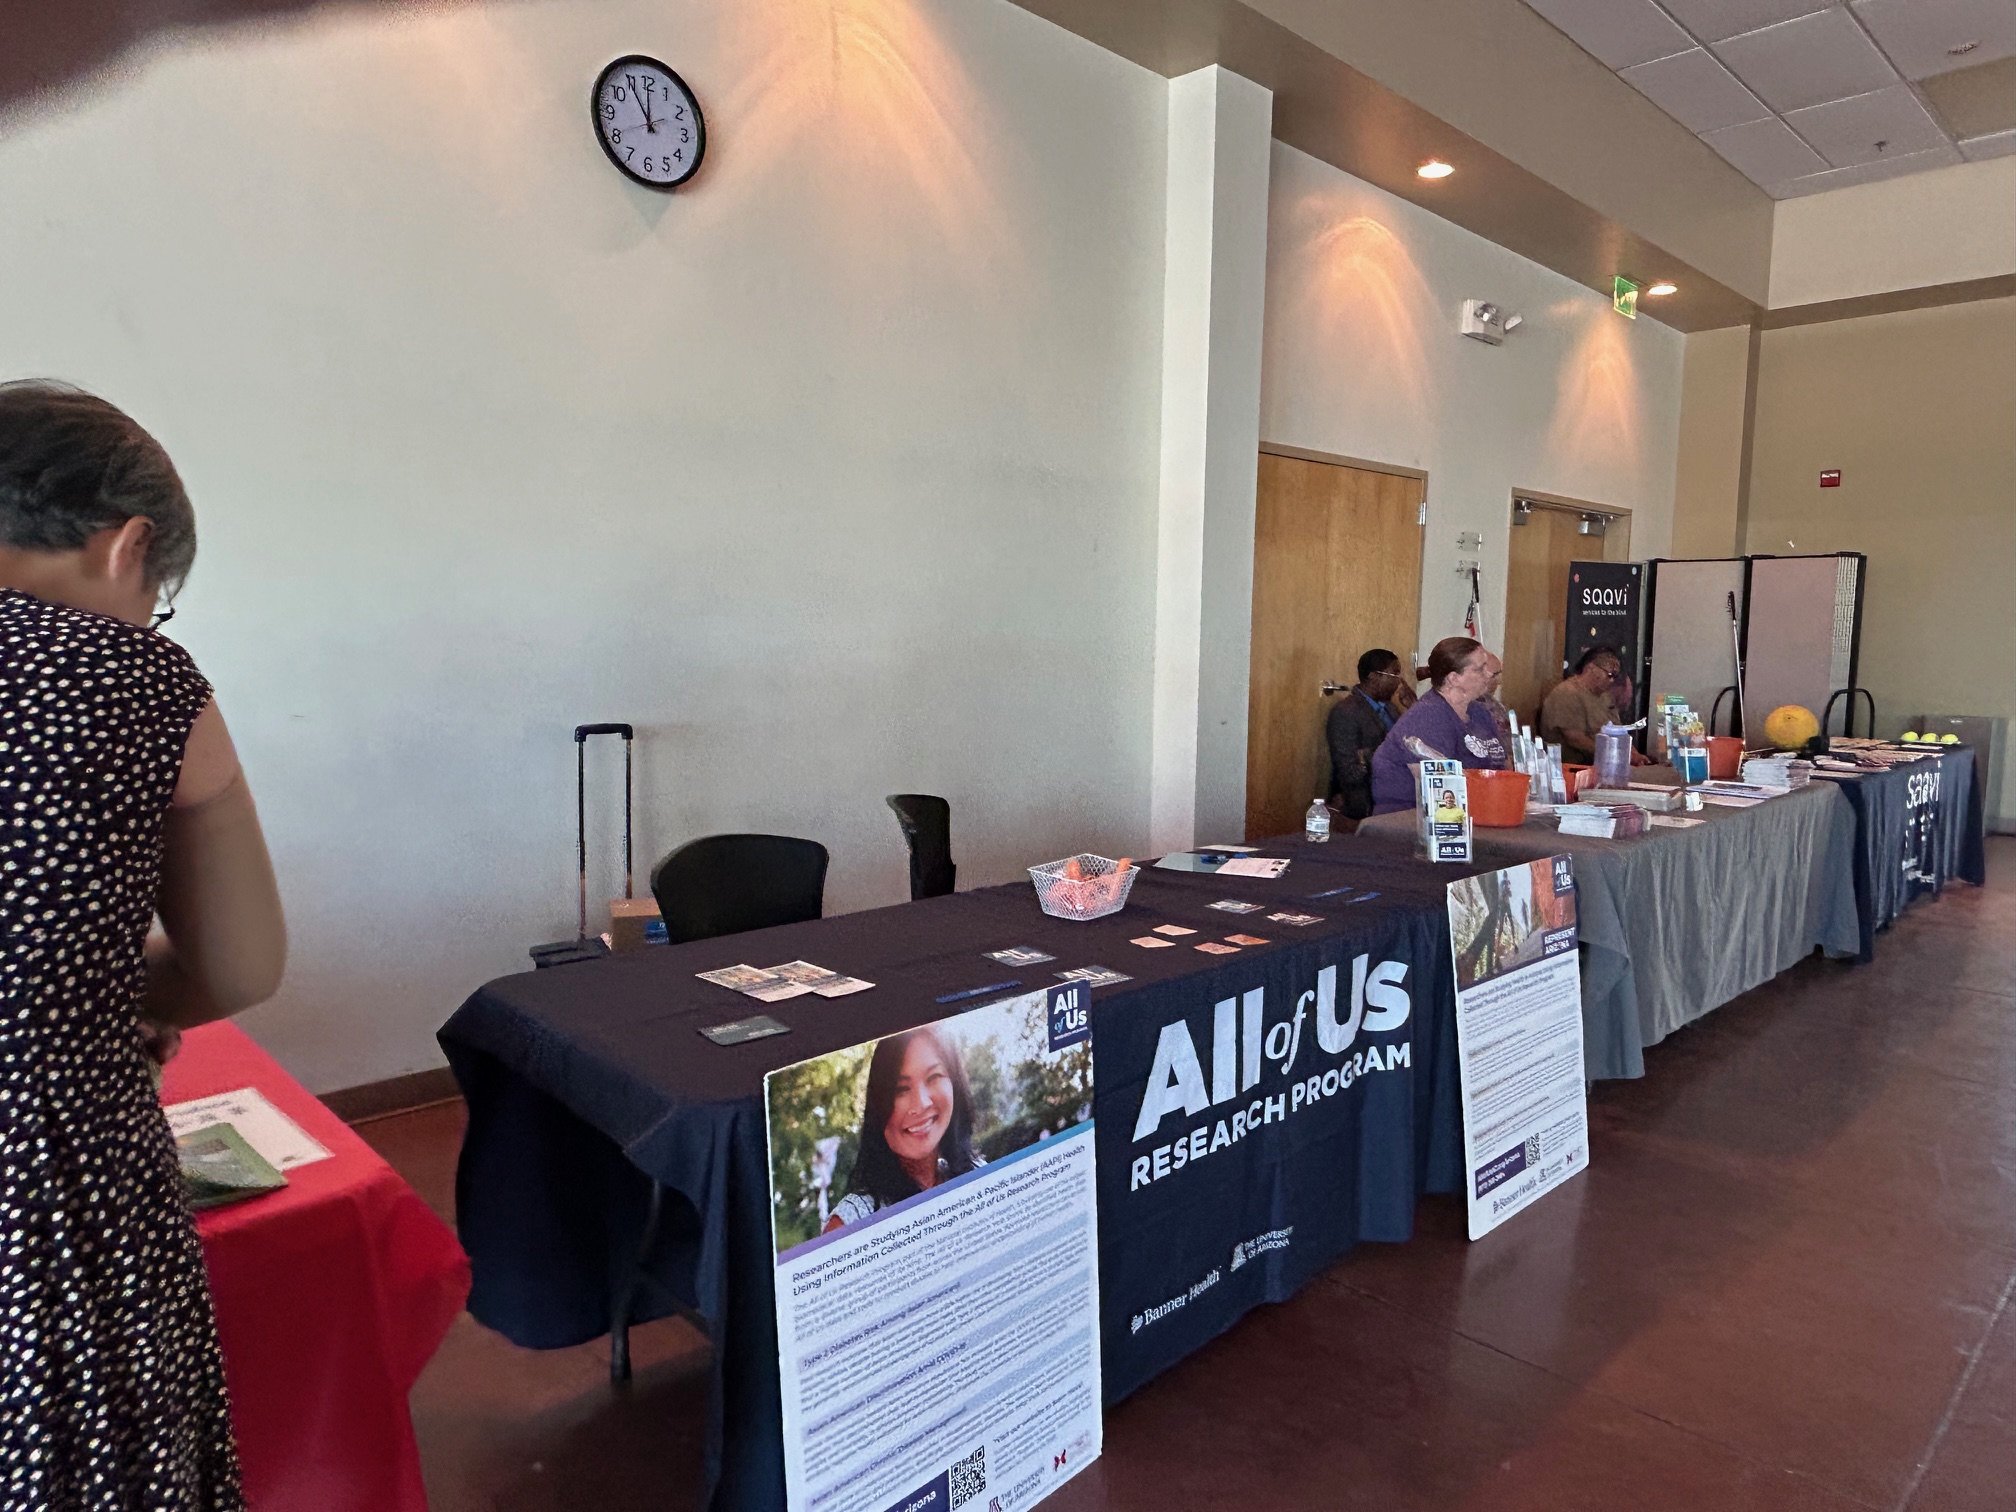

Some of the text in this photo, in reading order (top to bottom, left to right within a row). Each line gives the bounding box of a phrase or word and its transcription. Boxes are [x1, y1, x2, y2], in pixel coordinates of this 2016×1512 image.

[641, 75, 655, 92] 12
[611, 85, 626, 102] 10
[663, 87, 668, 101] 1
[606, 105, 615, 120] 9
[675, 105, 684, 121] 2
[612, 128, 621, 144] 8
[680, 128, 689, 143] 3
[626, 147, 635, 161] 7
[673, 148, 683, 162] 4
[644, 157, 652, 172] 6
[662, 156, 670, 172] 5
[1053, 988, 1078, 1015] All
[1054, 1009, 1088, 1033] of Us
[1132, 986, 1264, 1143] All
[1265, 990, 1314, 1075] of
[1317, 953, 1411, 1055] Us
[1130, 1092, 1285, 1192] RESEARCH
[1291, 1042, 1411, 1113] PROGRAM
[793, 1278, 822, 1297] Using
[824, 1252, 880, 1282] Information
[881, 1230, 922, 1256] Collected
[922, 1215, 959, 1237] Through
[959, 1208, 974, 1220] the
[1006, 1177, 1040, 1199] Research
[1041, 1163, 1072, 1181] Program
[793, 1250, 852, 1283] Researchers
[853, 1243, 869, 1256] are
[870, 1225, 911, 1248] Studying
[911, 1214, 936, 1230] Asian
[937, 1195, 976, 1219] American
[1257, 1238, 1290, 1255] ARIZONA
[1144, 1269, 1220, 1326] Banner Health
